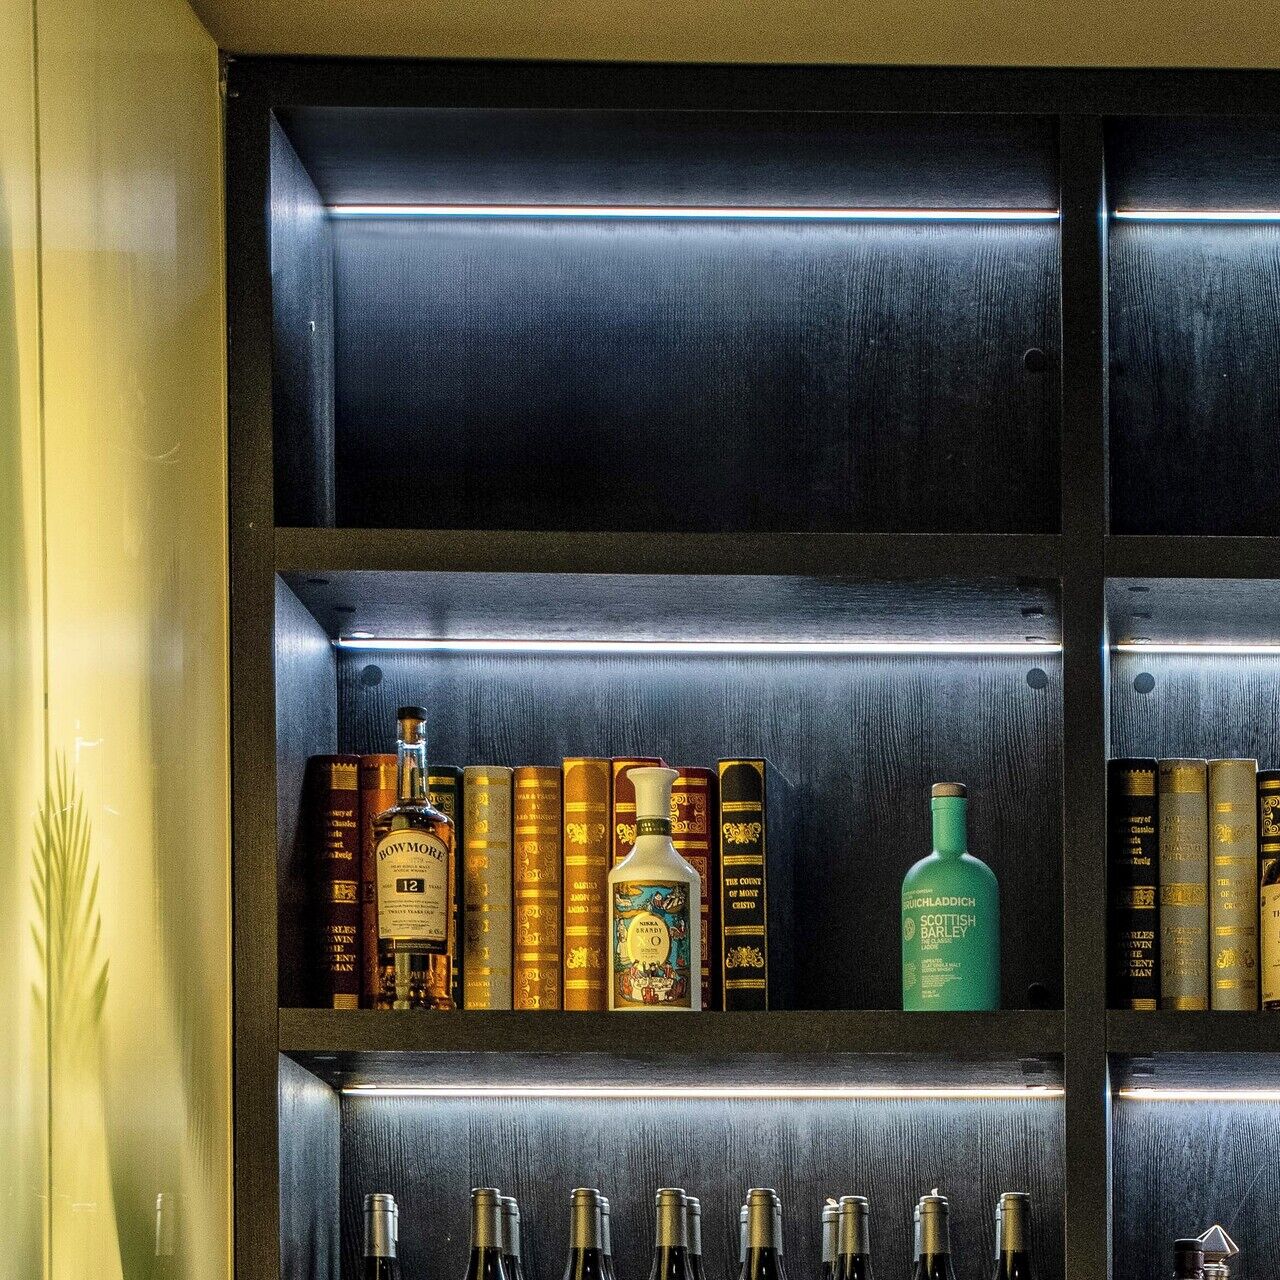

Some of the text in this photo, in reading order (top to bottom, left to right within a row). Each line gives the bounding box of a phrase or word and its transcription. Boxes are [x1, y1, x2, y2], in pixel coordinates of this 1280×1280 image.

[379, 842, 445, 862] BOWMORE
[403, 880, 418, 891] 12
[726, 878, 738, 886] THE
[921, 914, 976, 926] SCOTTISH
[921, 926, 967, 938] BARLEY
